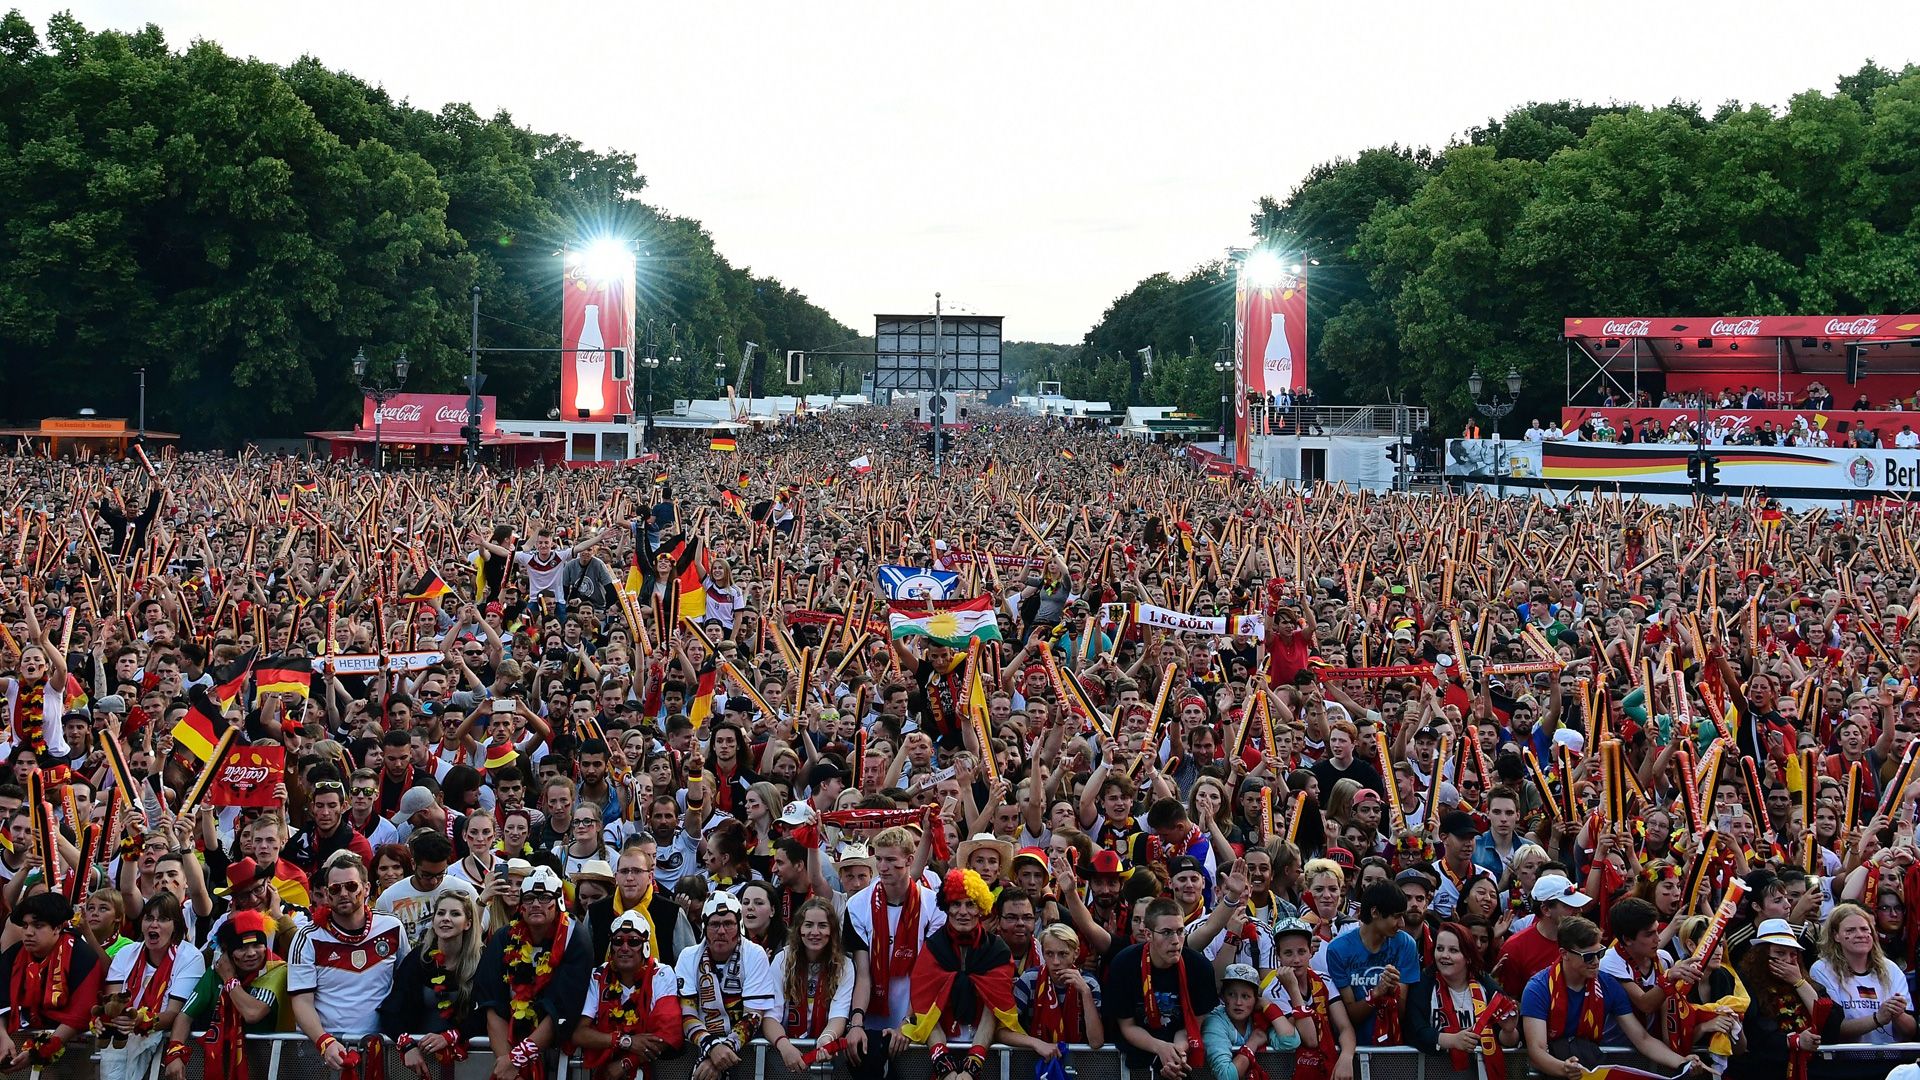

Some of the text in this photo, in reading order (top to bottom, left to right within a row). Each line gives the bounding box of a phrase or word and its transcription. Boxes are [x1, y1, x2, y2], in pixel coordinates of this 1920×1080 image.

[1602, 319, 1652, 336] Coca-Cola
[1711, 319, 1762, 336] Coca-Cola
[1824, 318, 1879, 335] Coca-Cola
[436, 405, 486, 423] Coca-Co
[1150, 610, 1214, 631] 1. FC KÖLN
[1350, 973, 1379, 986] Hard
